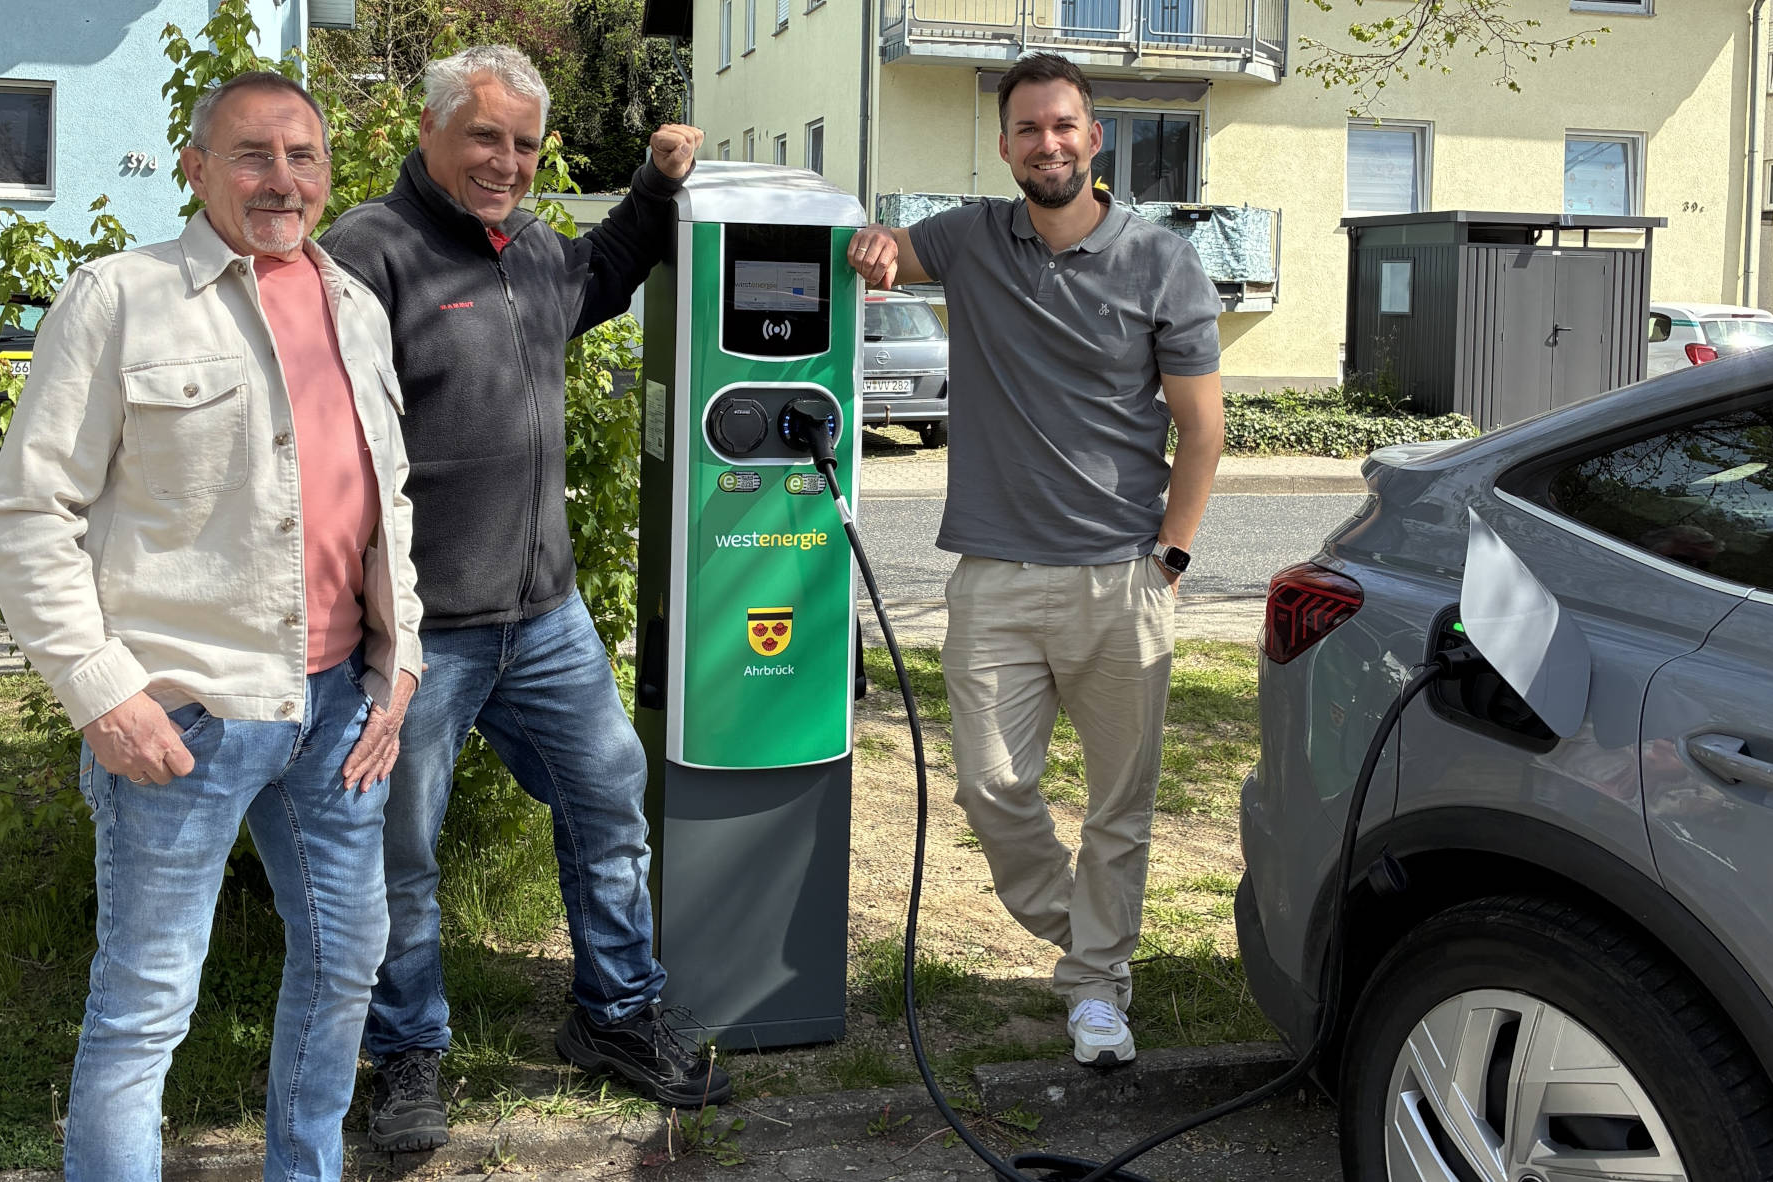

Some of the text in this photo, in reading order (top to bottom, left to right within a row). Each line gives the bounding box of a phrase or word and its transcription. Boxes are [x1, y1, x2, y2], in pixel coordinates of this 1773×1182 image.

[127, 151, 159, 169] 39d
[892, 380, 909, 391] 282
[715, 528, 828, 550] westenergie
[743, 664, 794, 677] Ahrbrück
